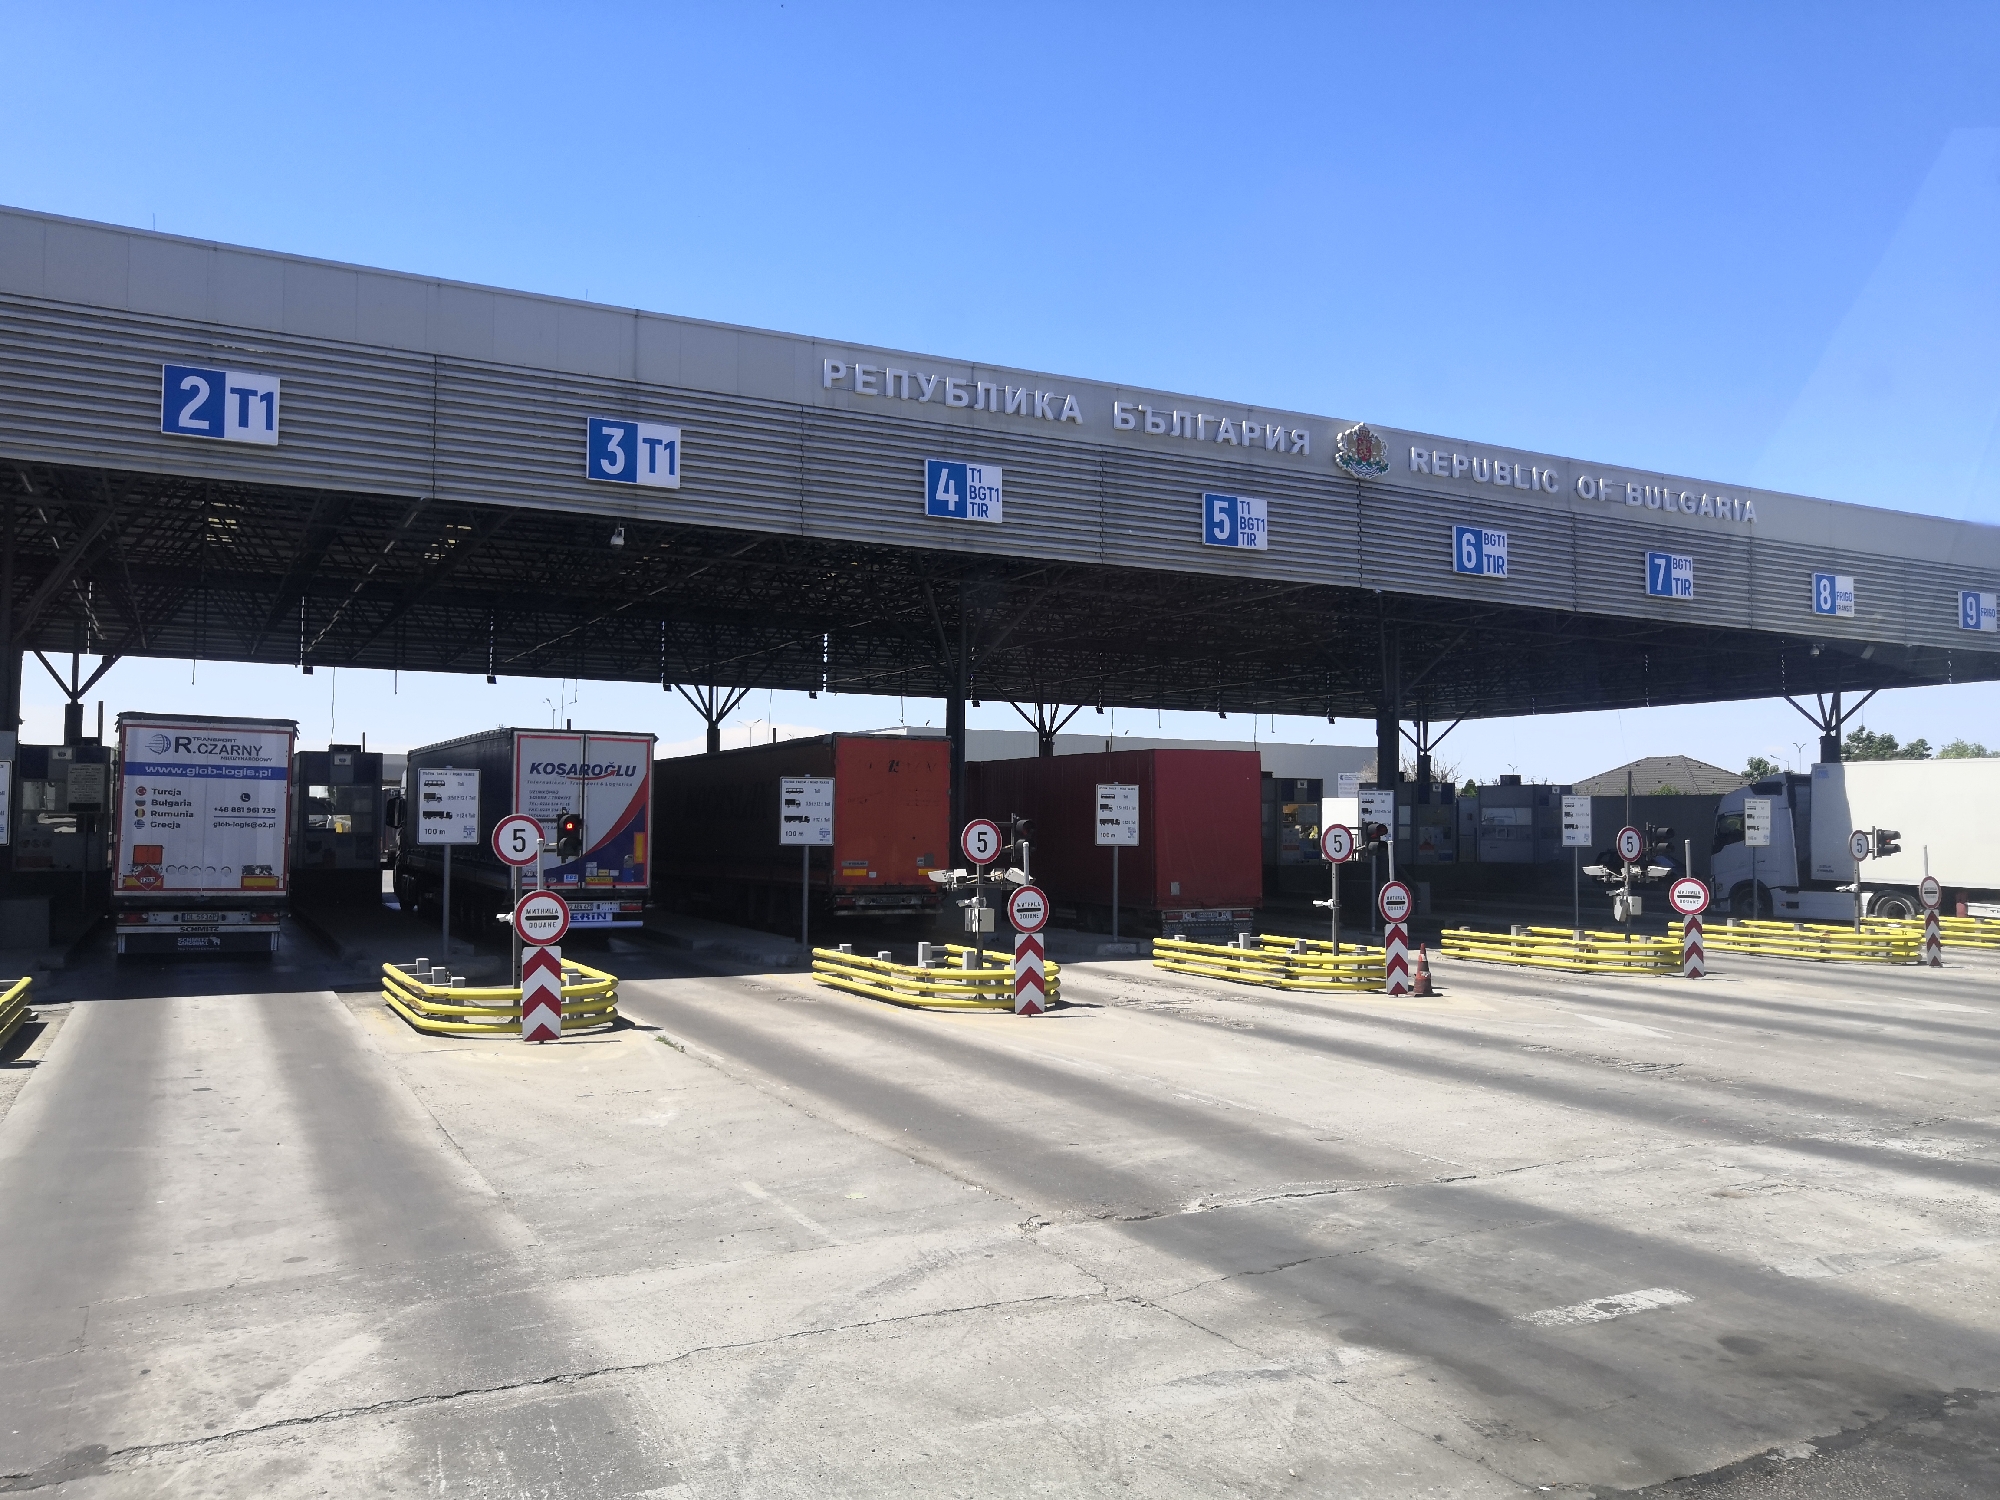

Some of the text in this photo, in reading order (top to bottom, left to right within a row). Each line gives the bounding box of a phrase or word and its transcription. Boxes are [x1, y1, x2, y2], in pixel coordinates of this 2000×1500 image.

[178, 375, 274, 431] 2 T1
[823, 358, 1310, 456] РЕПУБЛИКА БЪЛГАРИЯ
[600, 426, 675, 476] 3 T1
[968, 467, 982, 484] T1
[935, 468, 959, 511] 4
[1408, 446, 1758, 523] REPUBLIC OF BULGARIA
[969, 485, 1000, 502] BGT1
[969, 502, 989, 518] TIR
[1239, 501, 1250, 515] T1
[1213, 500, 1230, 540] 5
[1239, 516, 1265, 532] BGT1
[1240, 532, 1257, 546] TIR
[1484, 533, 1505, 547] BGT1
[1461, 532, 1477, 569] 6
[1484, 554, 1505, 575] TIR
[1672, 558, 1692, 571] BGT1
[1653, 558, 1666, 591] 7
[1673, 577, 1692, 596] TIR
[1819, 579, 1832, 610] 8
[1966, 596, 1977, 626] 9
[145, 765, 272, 778] www.glob-logis.pl
[151, 787, 182, 796] Turcja
[150, 809, 194, 818] Rumunia
[149, 820, 181, 829] Grecja
[213, 820, 276, 829] glob-logis@o2.pl
[512, 828, 526, 852] 5
[976, 831, 988, 853] 5
[1333, 834, 1342, 853] 5
[1626, 836, 1634, 853] 5
[1856, 838, 1863, 854] 5
[528, 921, 557, 929] DOUANE
